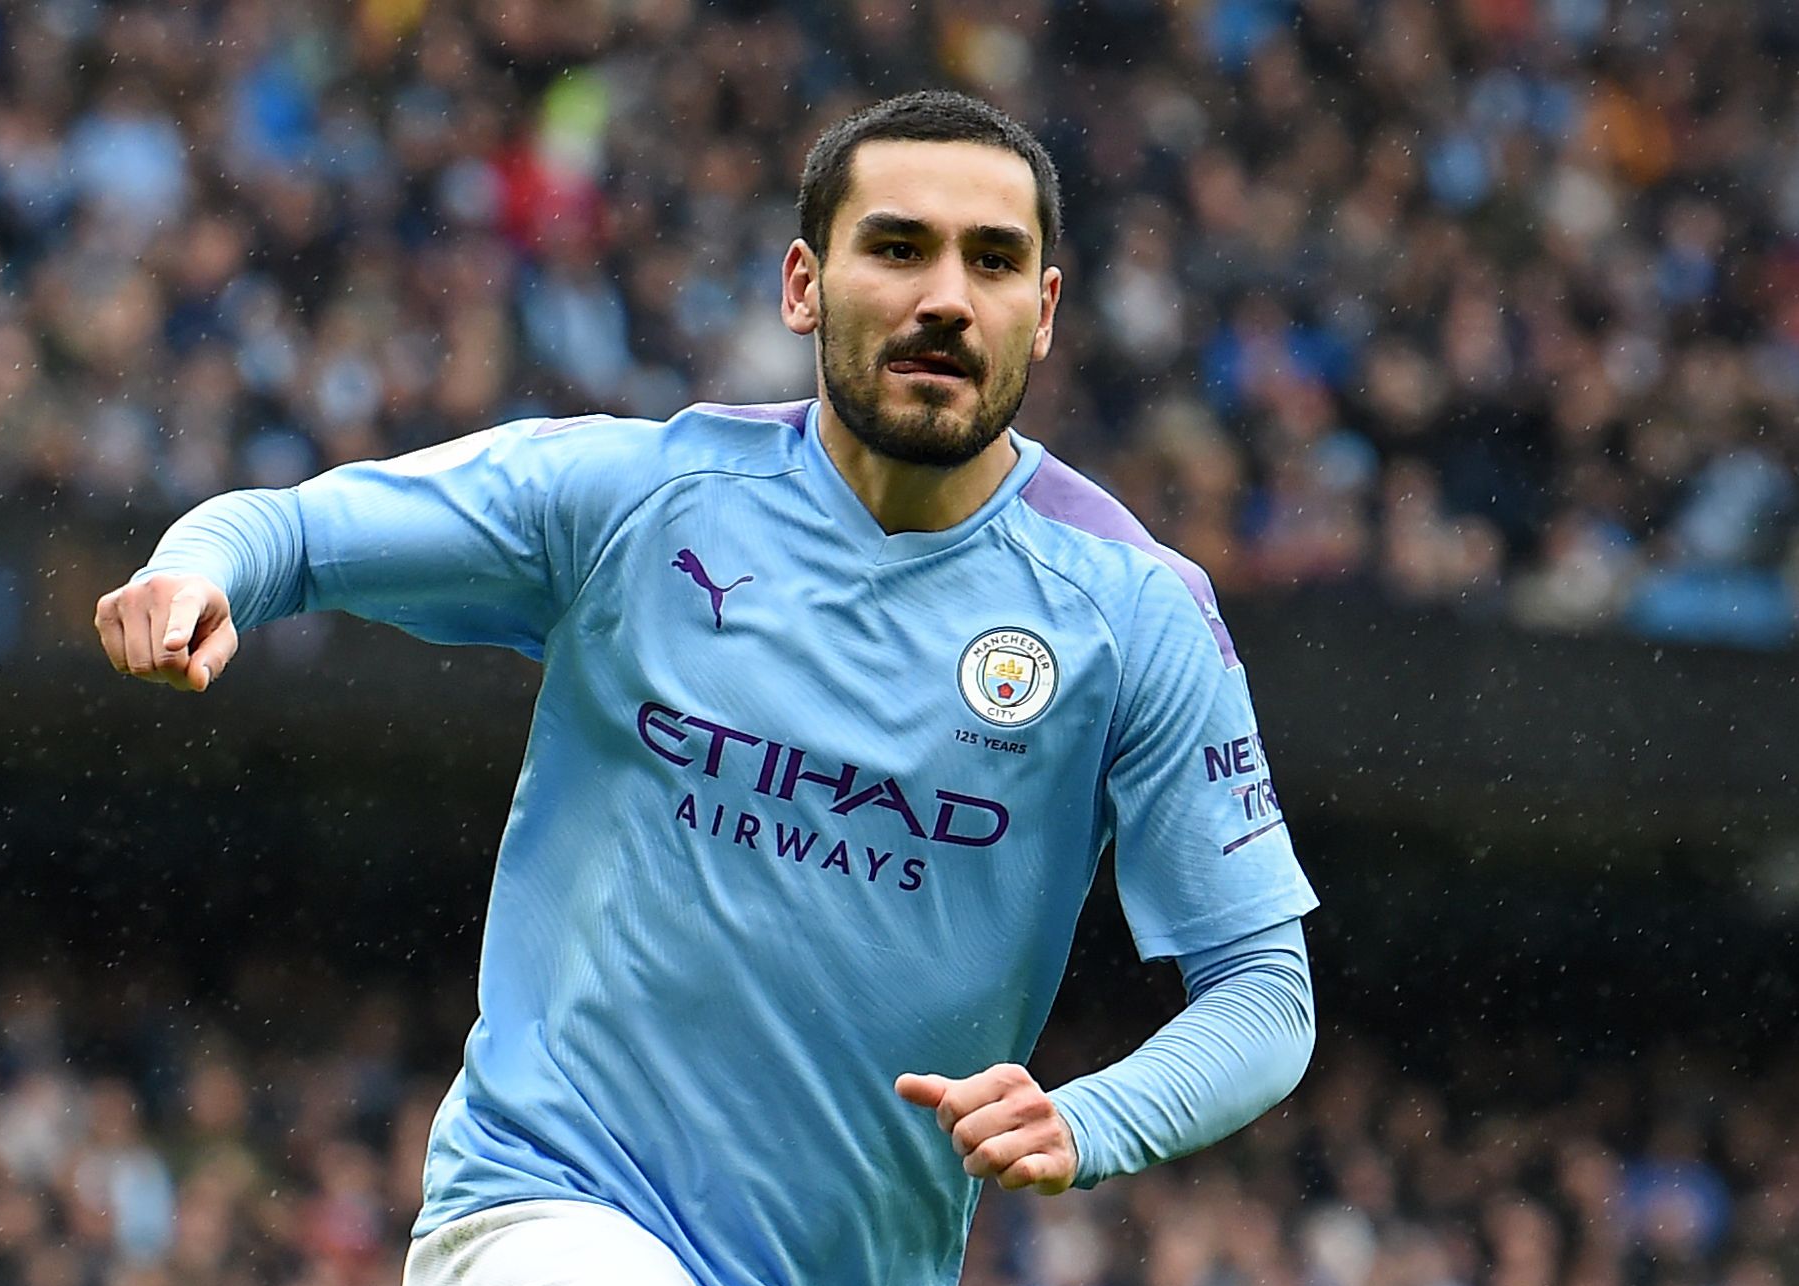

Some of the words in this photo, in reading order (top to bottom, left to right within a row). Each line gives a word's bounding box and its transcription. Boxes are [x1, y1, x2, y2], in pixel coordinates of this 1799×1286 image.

[974, 634, 1050, 670] MANCHESTER
[987, 707, 1016, 720] CITY
[955, 729, 979, 744] 125
[984, 737, 1028, 754] YEARS
[637, 701, 1010, 848] ETIHAD
[675, 793, 925, 891] AIRWAYS
